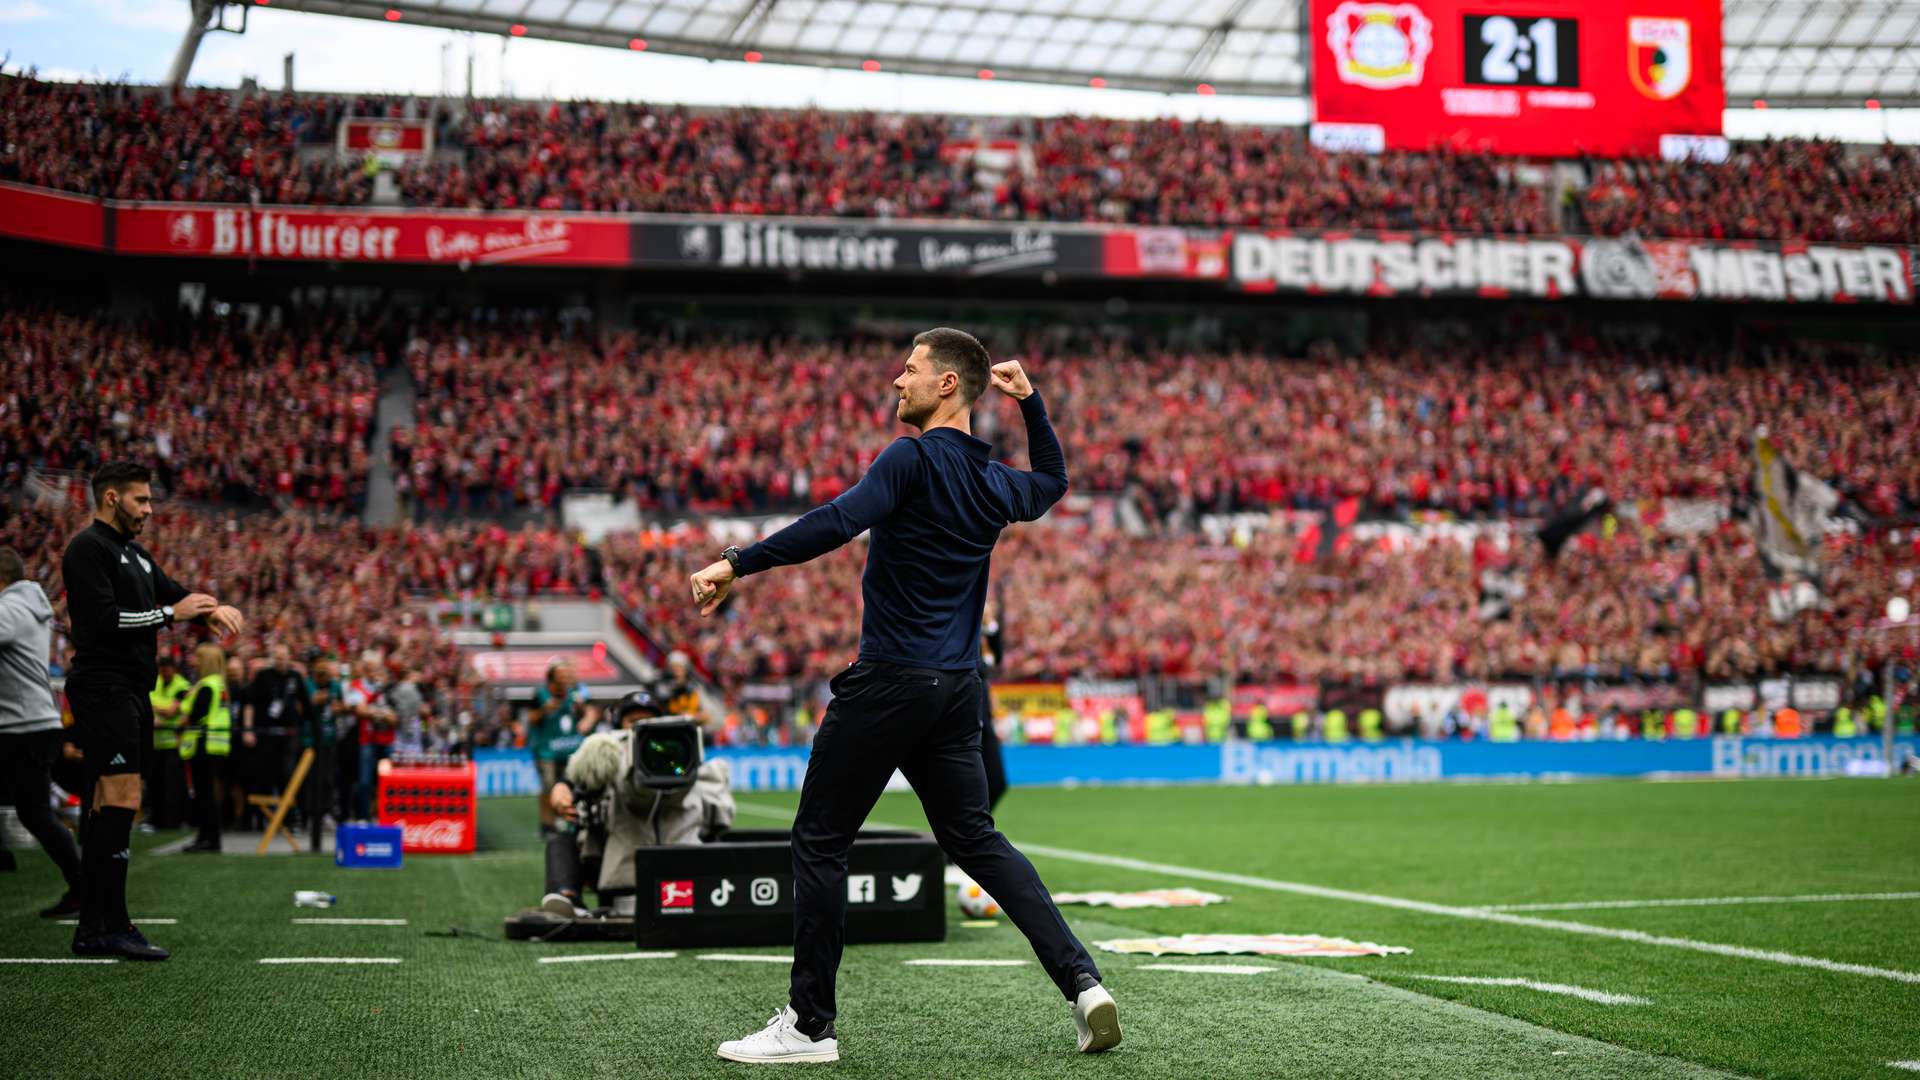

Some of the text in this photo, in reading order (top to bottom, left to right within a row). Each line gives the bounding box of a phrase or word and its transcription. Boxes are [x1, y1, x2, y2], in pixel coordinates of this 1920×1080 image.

[1479, 15, 1559, 84] 2:1
[212, 209, 399, 258] Bitburger
[720, 222, 898, 270] Bitburger
[1234, 233, 1910, 301] DEUTSCHER MEISTER
[1221, 738, 1442, 783] Barmenia
[1713, 735, 1916, 777] Barmena
